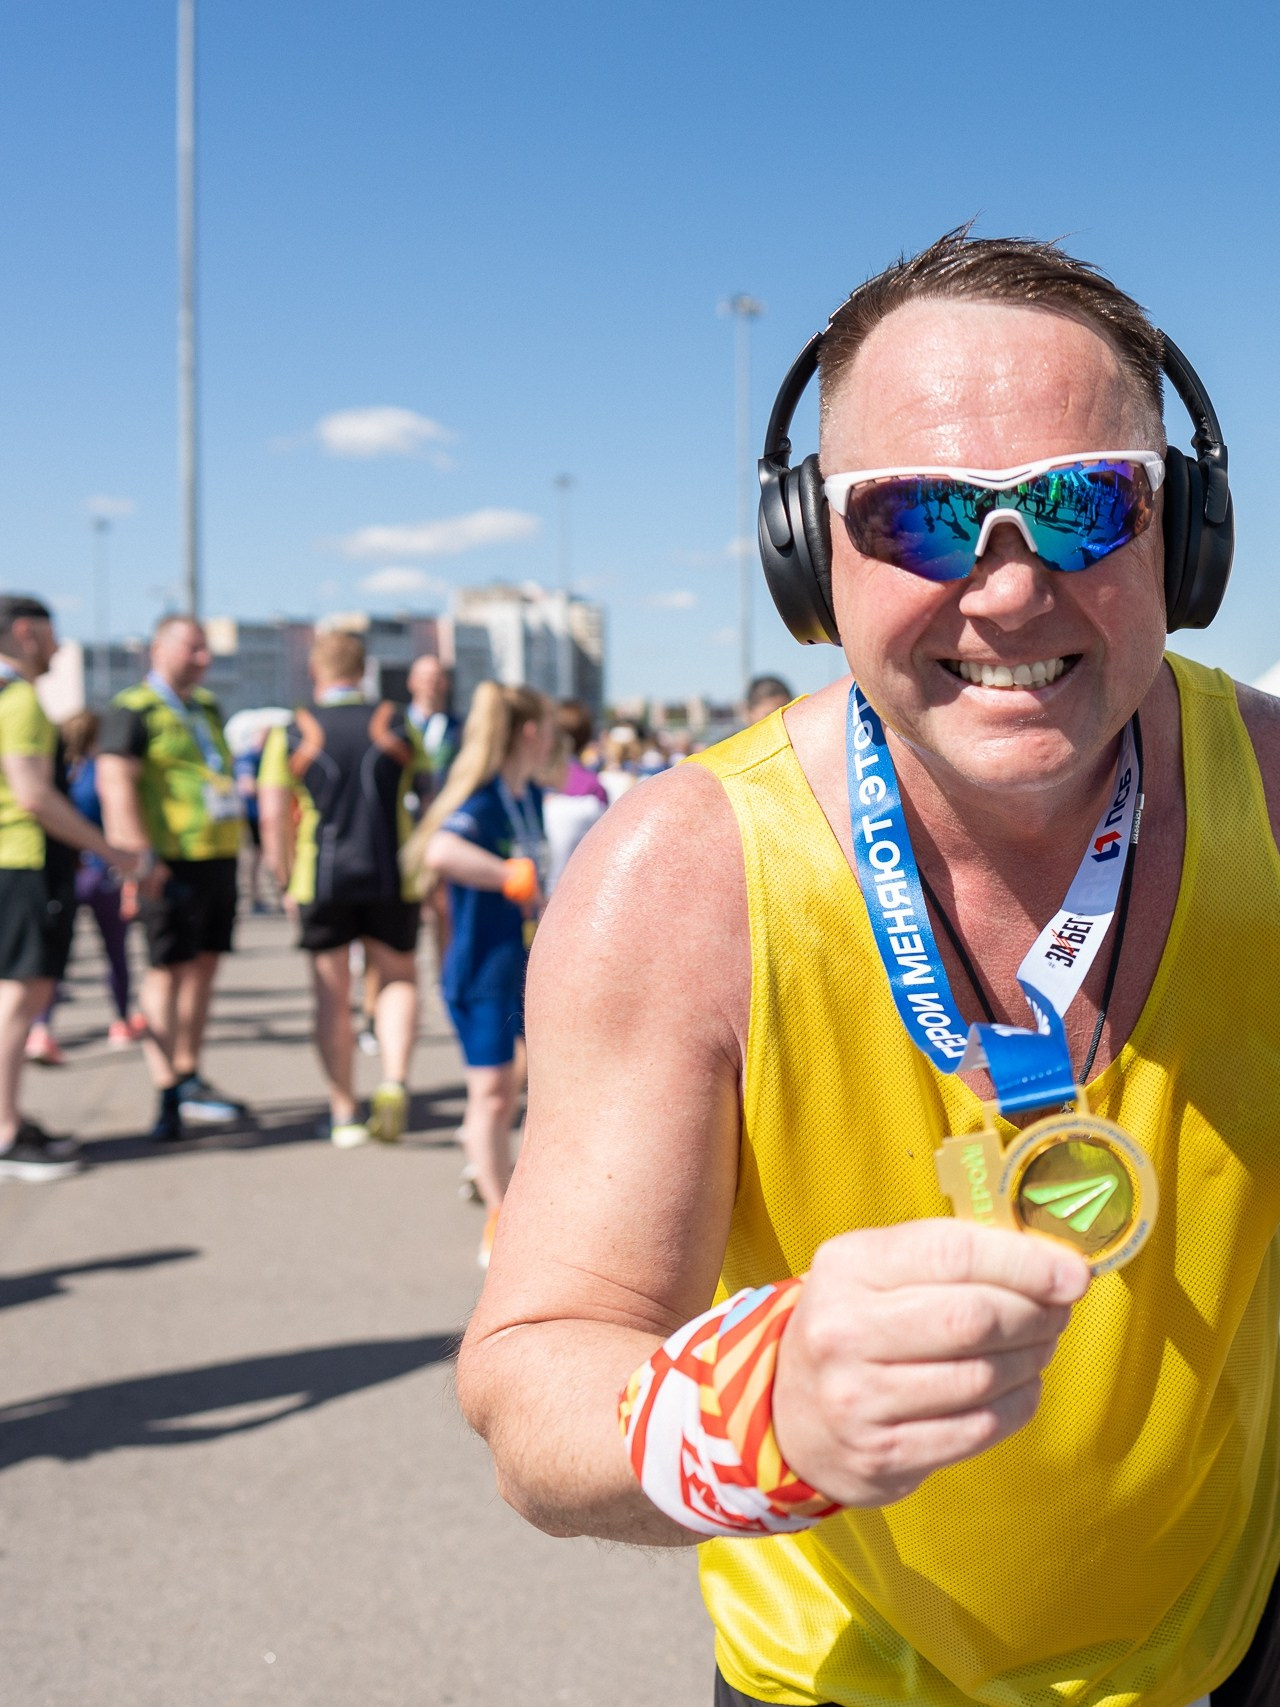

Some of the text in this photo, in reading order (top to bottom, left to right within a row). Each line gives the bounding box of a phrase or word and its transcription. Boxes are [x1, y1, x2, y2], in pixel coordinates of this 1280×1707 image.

[1104, 767, 1132, 828] ПСБ
[861, 814, 936, 987] МЕНЯЮТ
[1045, 916, 1094, 969] ЗАБЕГ
[909, 992, 969, 1059] ГЕРОИ
